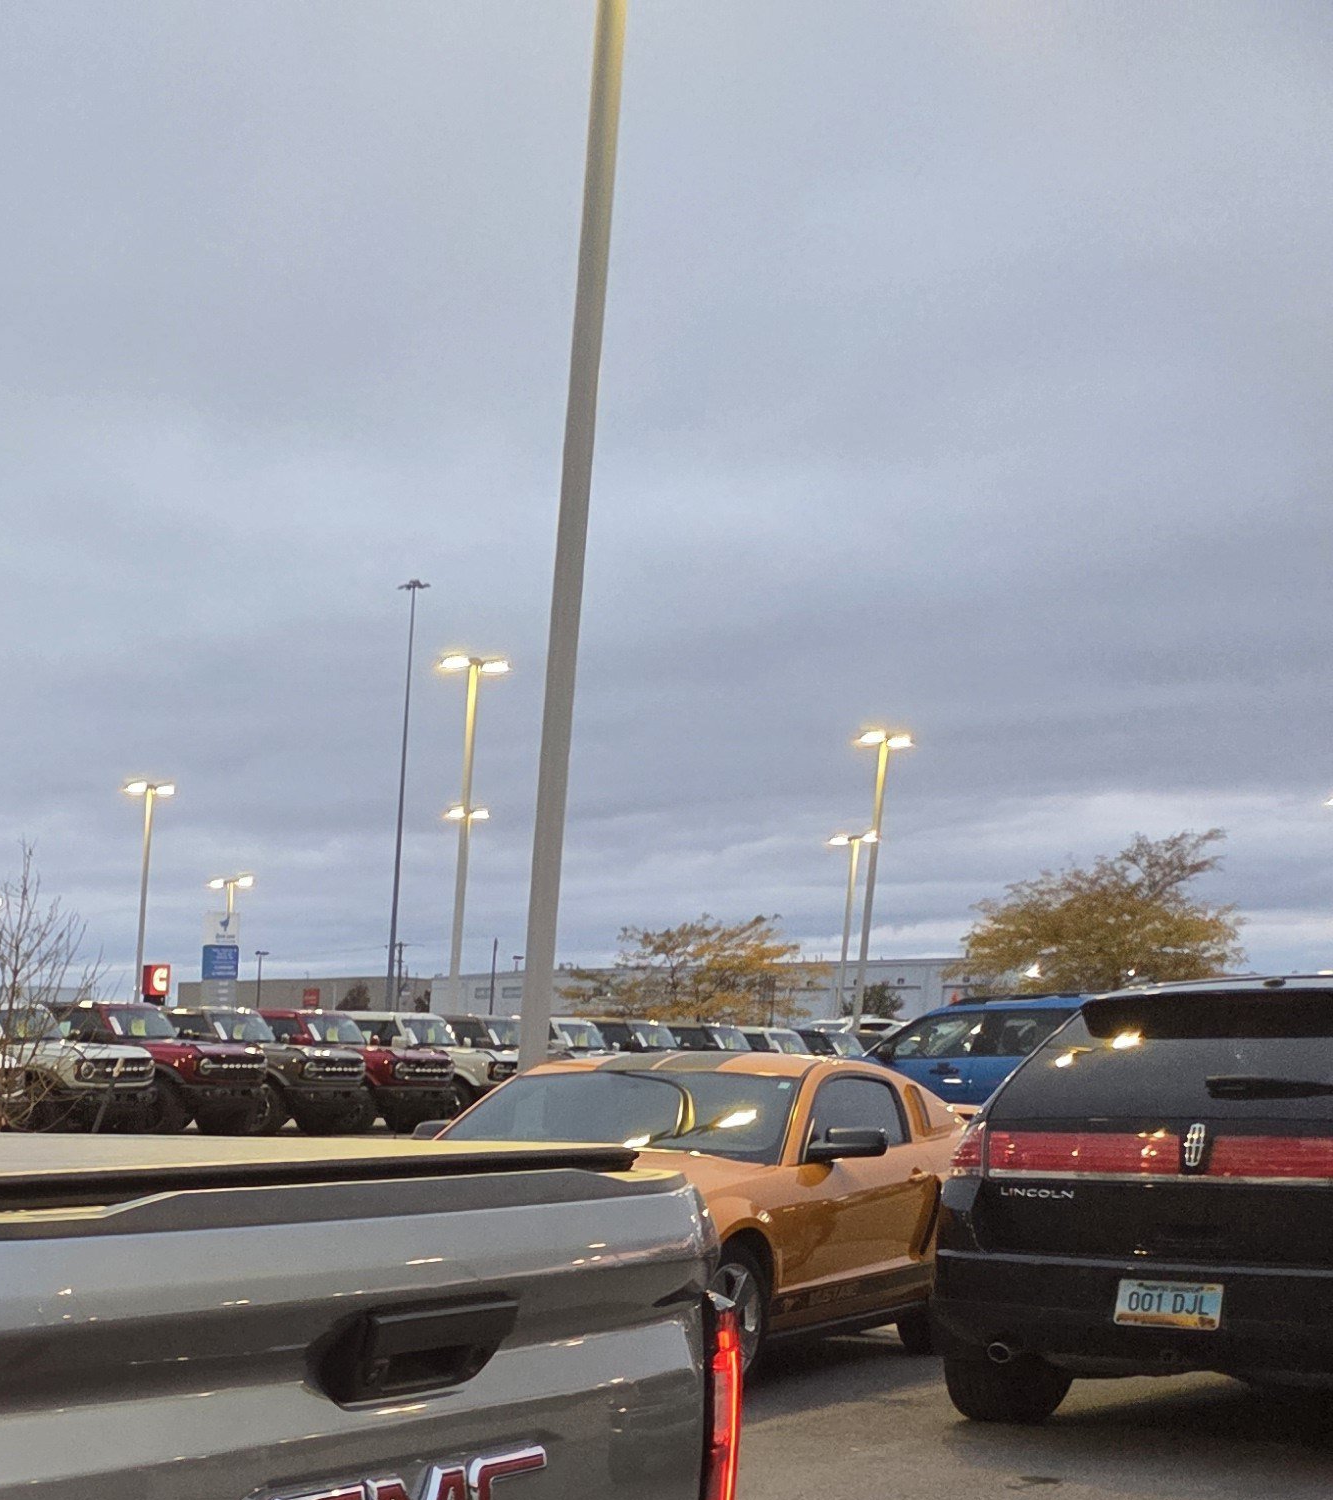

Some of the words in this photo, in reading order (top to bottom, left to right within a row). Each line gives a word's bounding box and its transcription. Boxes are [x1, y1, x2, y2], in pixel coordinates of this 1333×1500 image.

[1000, 1187, 1074, 1199] LINCOLN
[1128, 1291, 1163, 1312] 001
[1172, 1293, 1209, 1315] DJL
